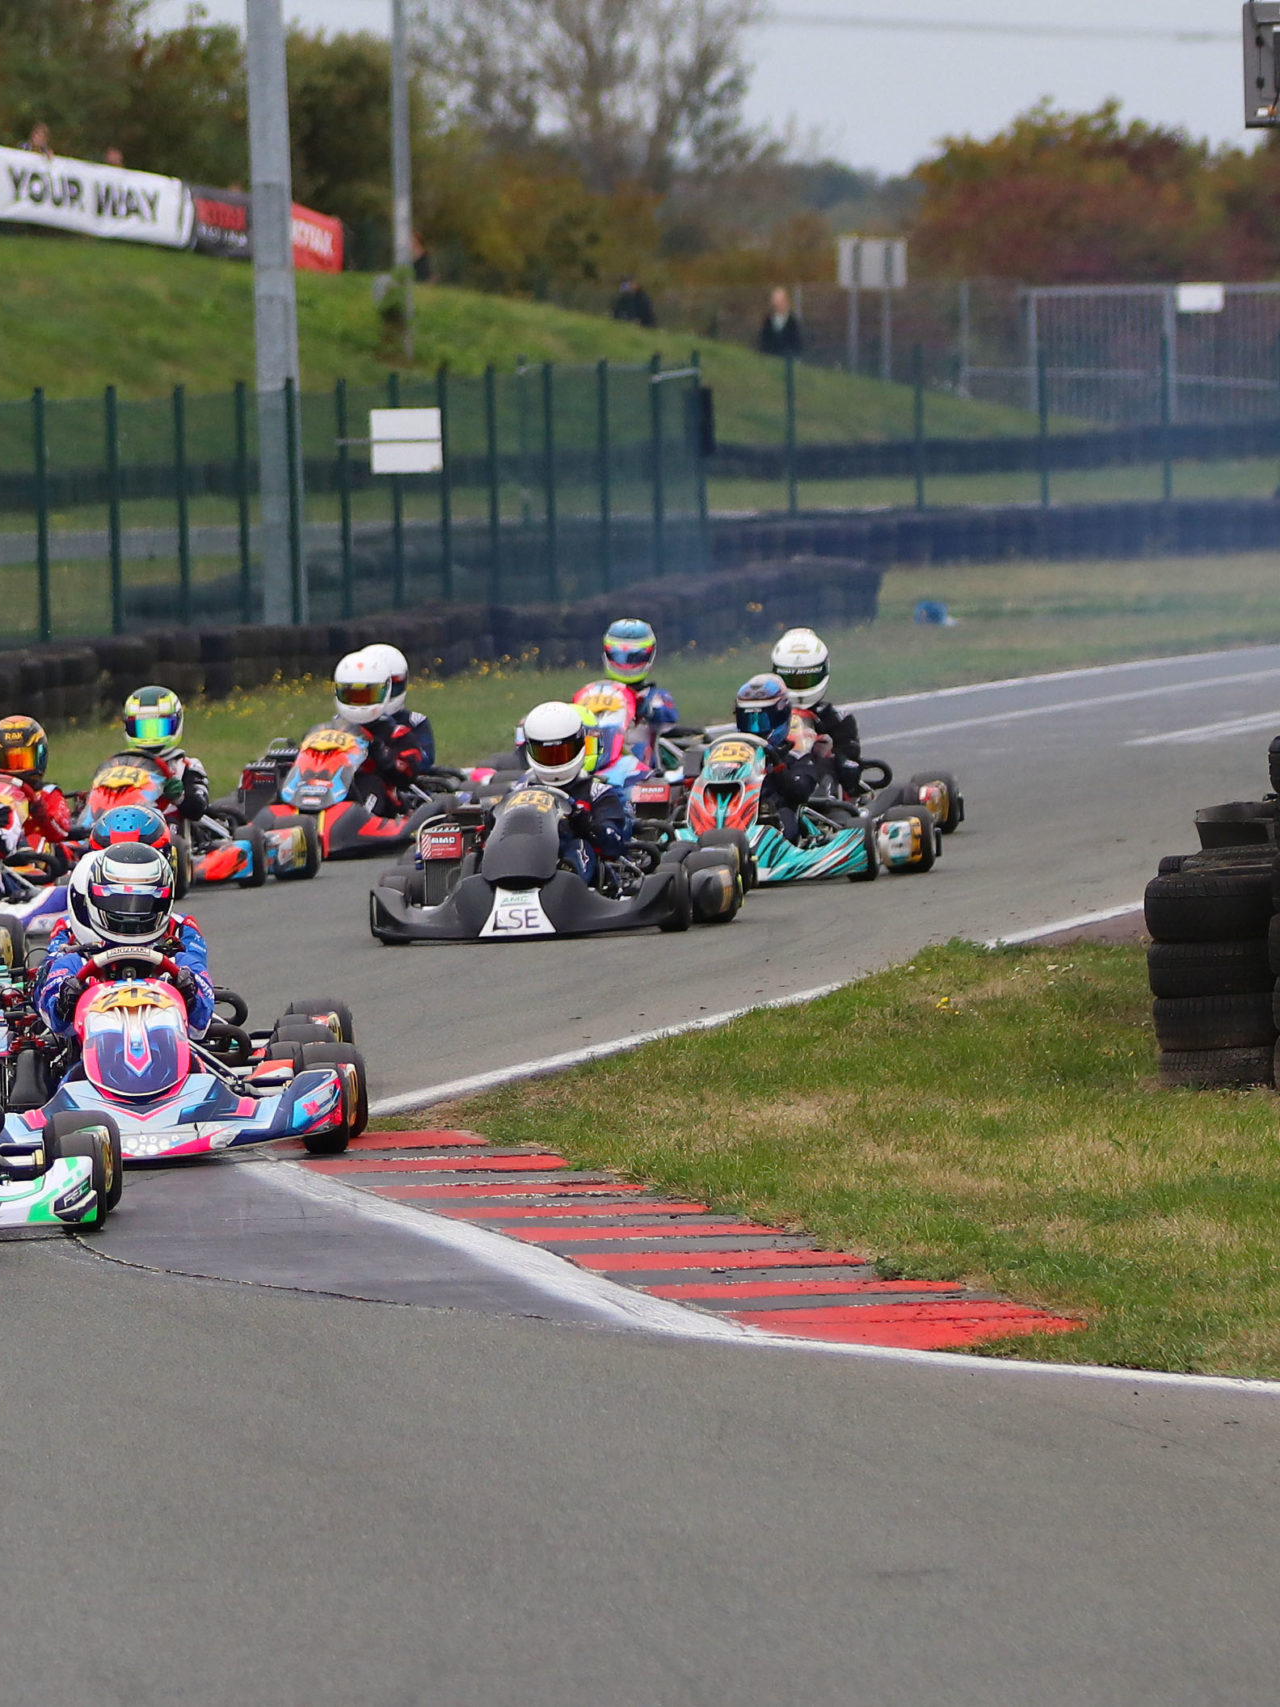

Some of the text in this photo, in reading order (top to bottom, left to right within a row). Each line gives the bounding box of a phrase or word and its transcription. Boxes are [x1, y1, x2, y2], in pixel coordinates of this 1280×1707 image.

[8, 168, 85, 212] YOUR
[95, 181, 160, 224] WAY
[493, 908, 540, 931] LSE
